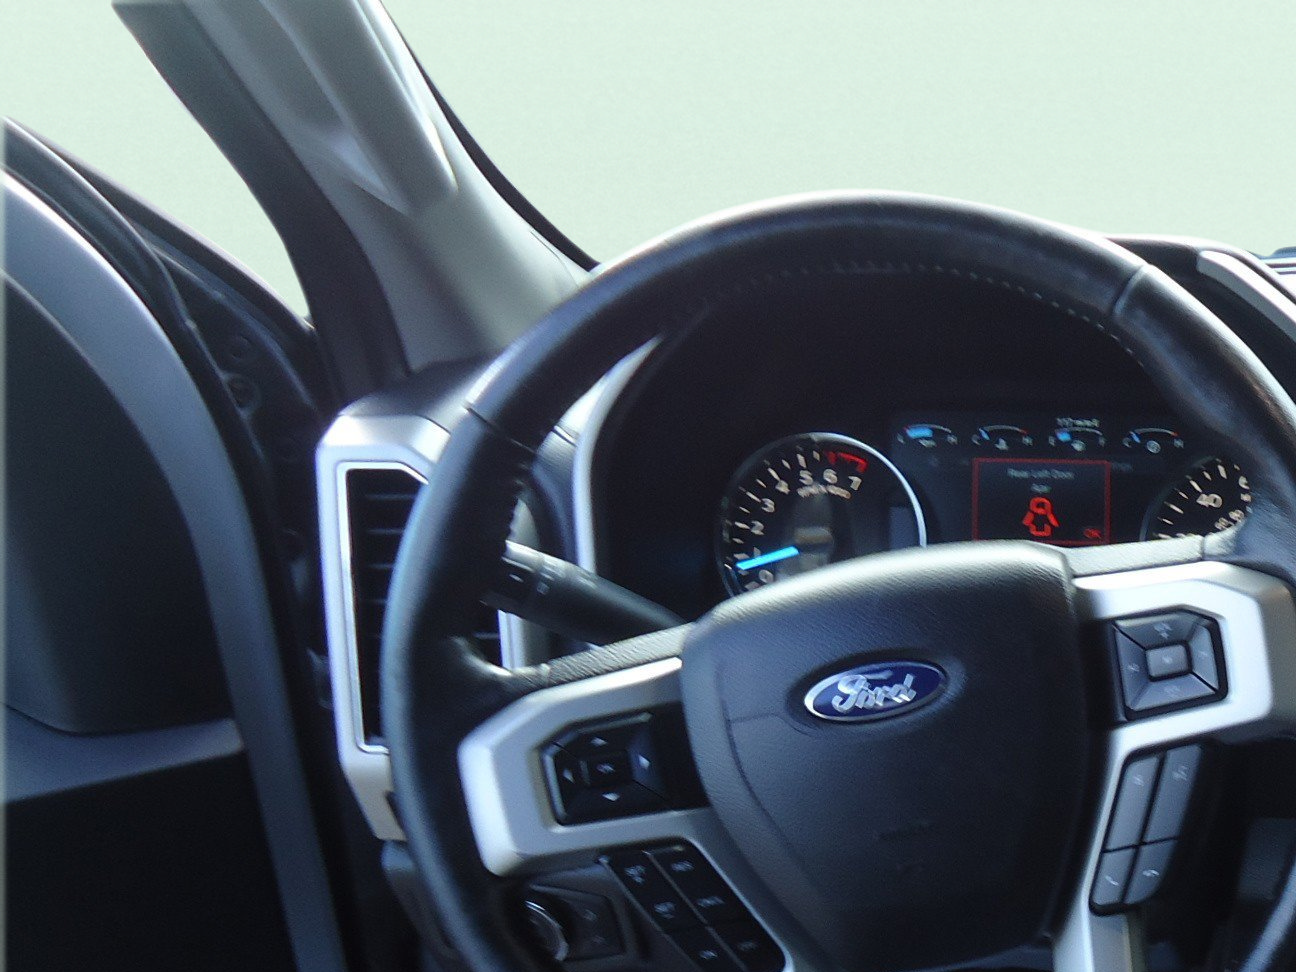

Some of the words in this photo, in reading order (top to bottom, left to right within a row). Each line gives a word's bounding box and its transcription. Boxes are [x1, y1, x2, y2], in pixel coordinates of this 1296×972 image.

[799, 469, 813, 486] 5
[823, 468, 838, 484] 6
[848, 475, 863, 491] 7
[775, 479, 790, 495] 4
[761, 498, 775, 513] 3
[1196, 493, 1223, 508] 40
[750, 521, 764, 535] 2
[759, 569, 774, 584] 0
[831, 670, 917, 714] Ford
